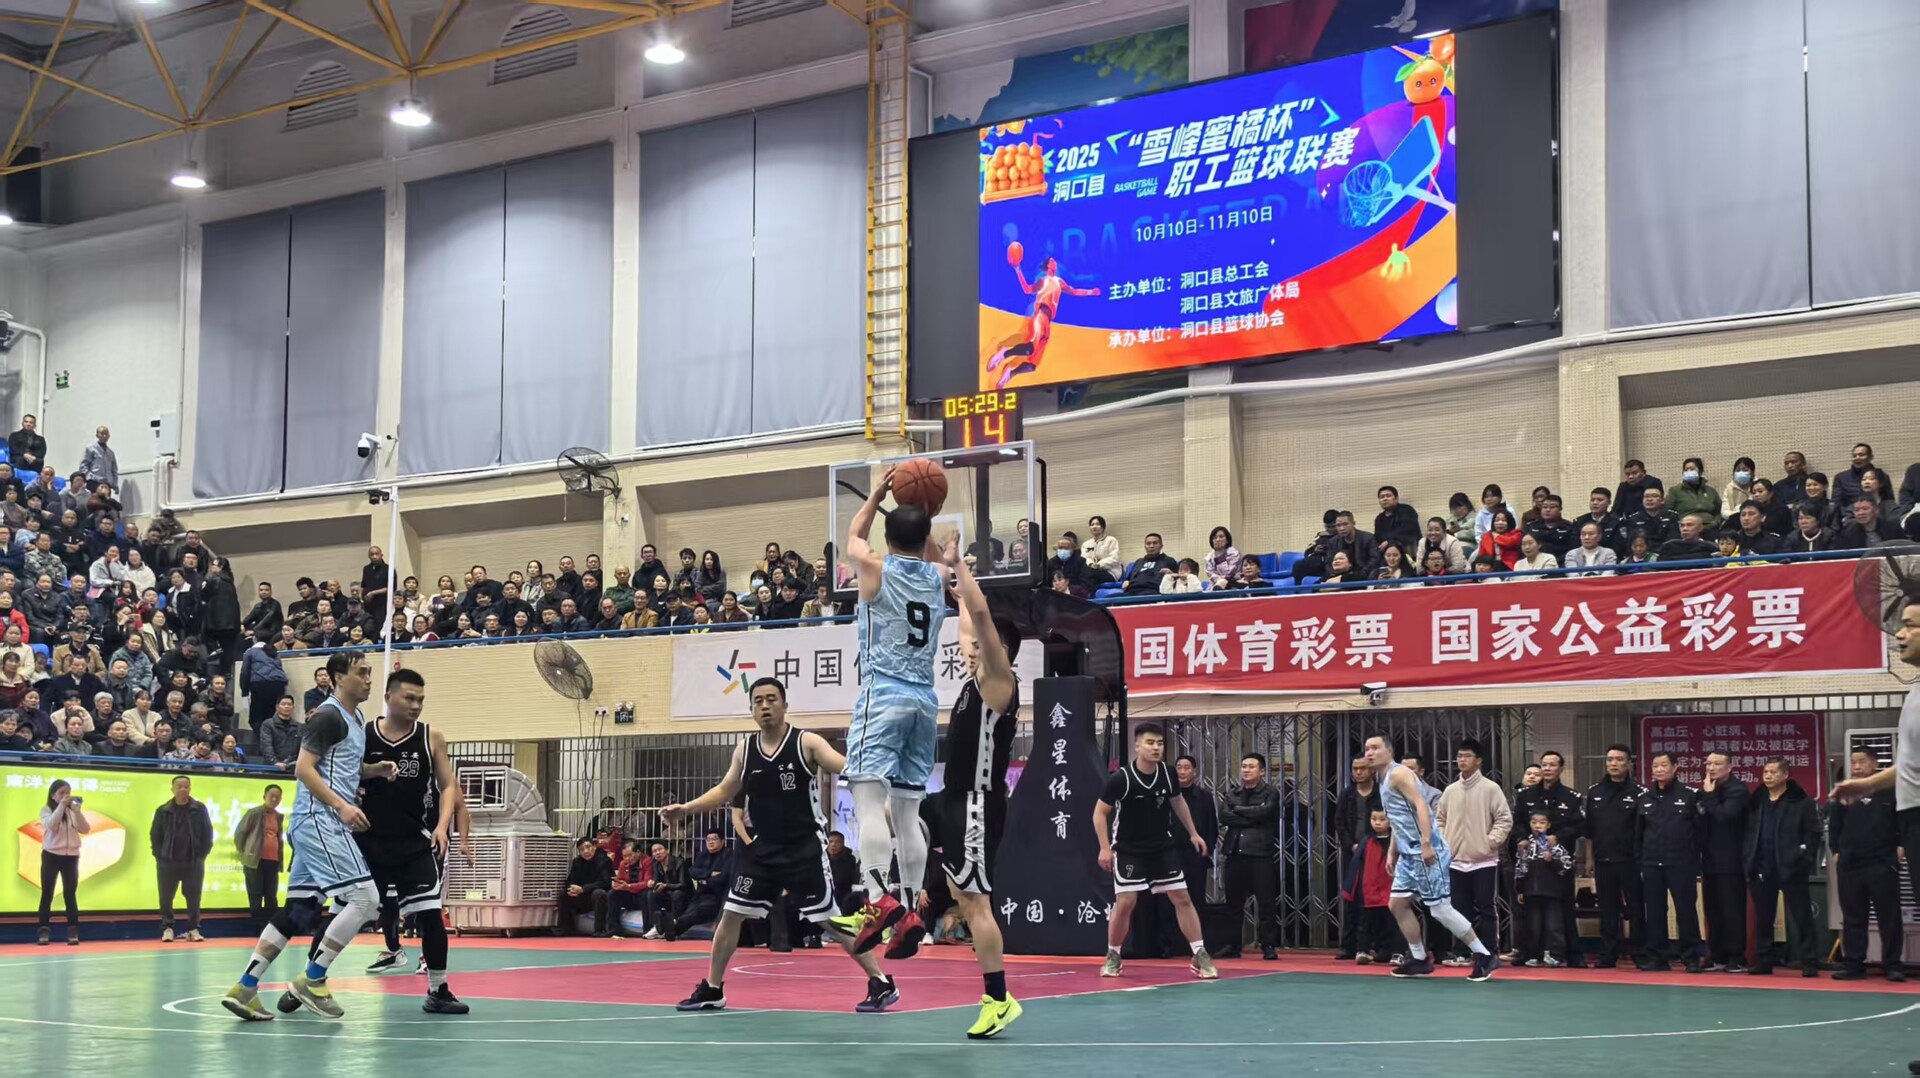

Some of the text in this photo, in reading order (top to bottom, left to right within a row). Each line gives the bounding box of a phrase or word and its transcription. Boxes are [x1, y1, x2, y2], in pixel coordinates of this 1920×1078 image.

[1128, 97, 1315, 168] “雪峰蜜橘杯”
[1056, 142, 1100, 173] 2025
[1164, 127, 1360, 198] 职工篮球联赛
[1053, 174, 1105, 203] 洞口县
[1114, 177, 1159, 193] BASKETBALL
[1137, 185, 1158, 198] GAME
[1180, 281, 1300, 314] 洞口县文旅广体局
[945, 392, 1017, 418] 05:29.2
[964, 414, 1004, 449] 14
[906, 601, 931, 648] 9
[1134, 587, 1806, 678] 国体育彩票 国家公益彩票
[398, 759, 420, 778] 29
[780, 772, 796, 791] 12
[1049, 702, 1073, 840] 鑫星体育
[734, 875, 753, 895] 12
[1126, 864, 1134, 878] 7
